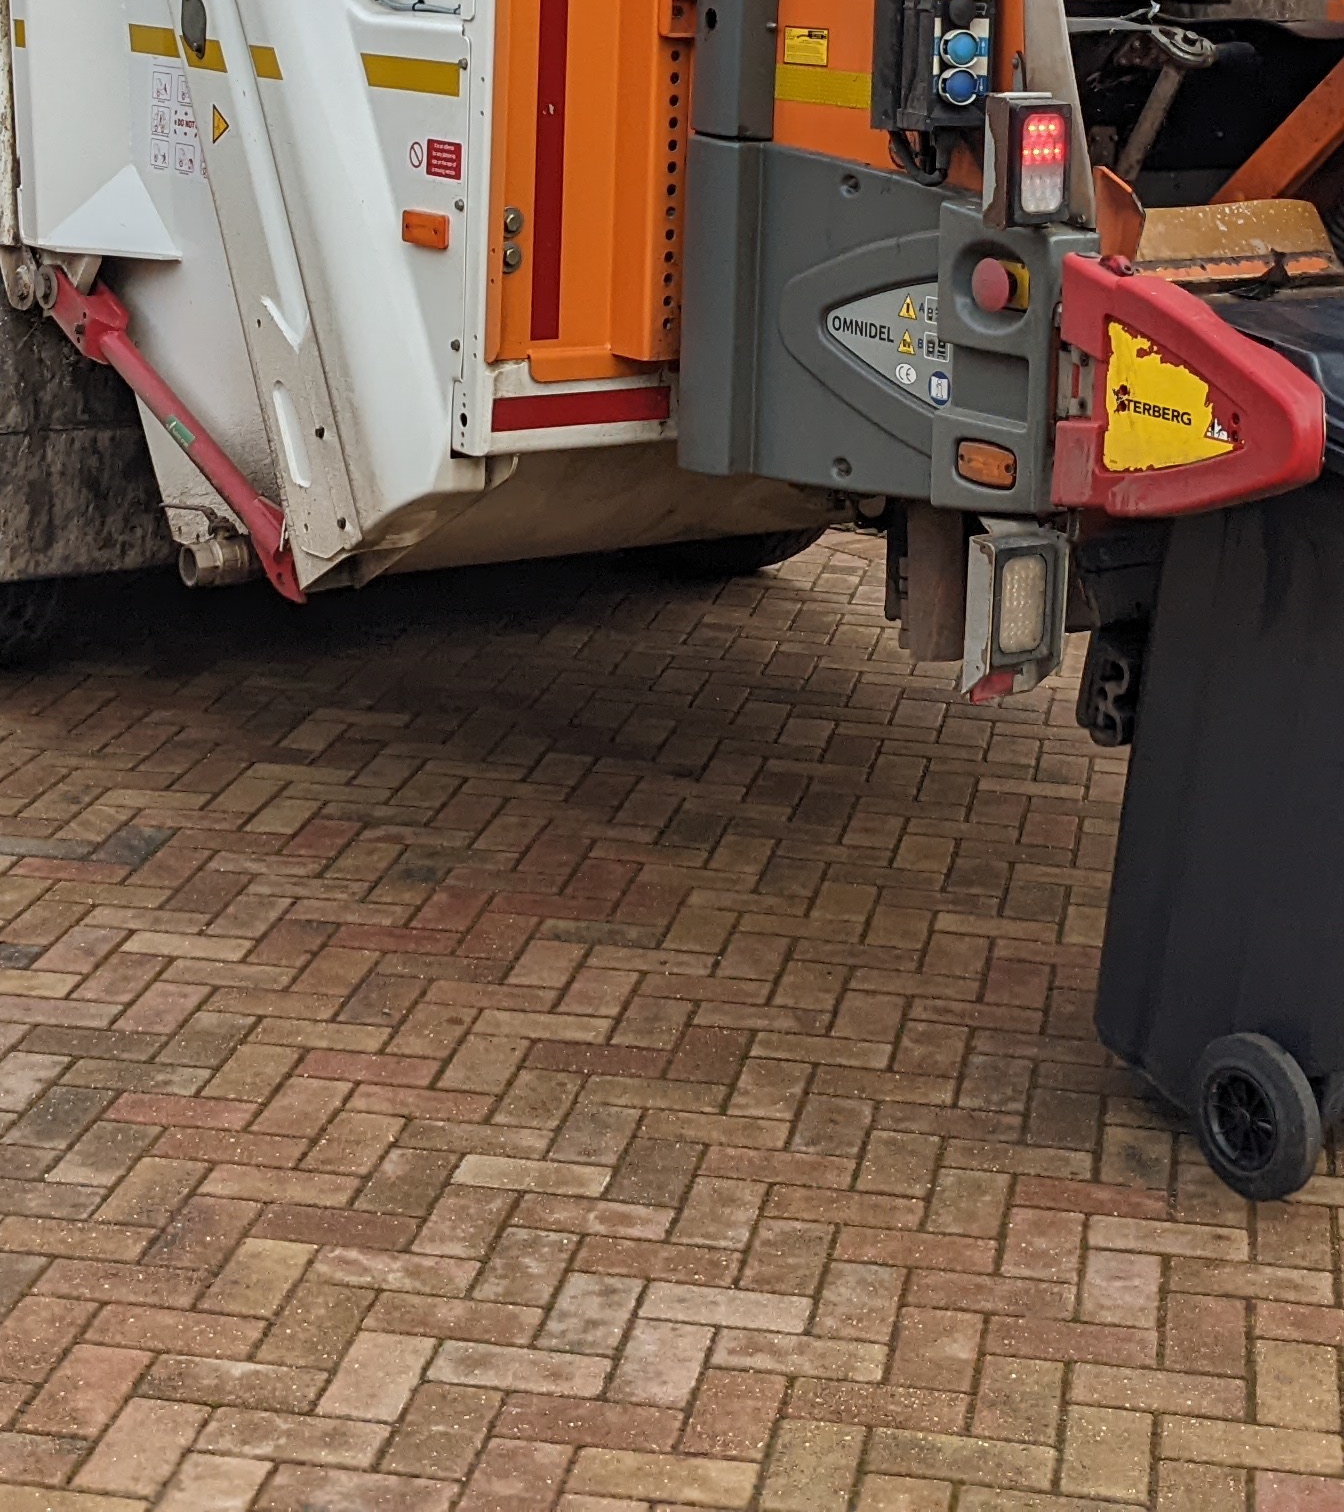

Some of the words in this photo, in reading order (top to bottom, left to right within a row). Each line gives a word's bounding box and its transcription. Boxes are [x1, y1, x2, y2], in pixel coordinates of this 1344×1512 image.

[177, 118, 185, 127] DO
[185, 119, 196, 129] NOT
[832, 315, 895, 344] OMNIDEL
[1126, 398, 1192, 426] TERBERG
